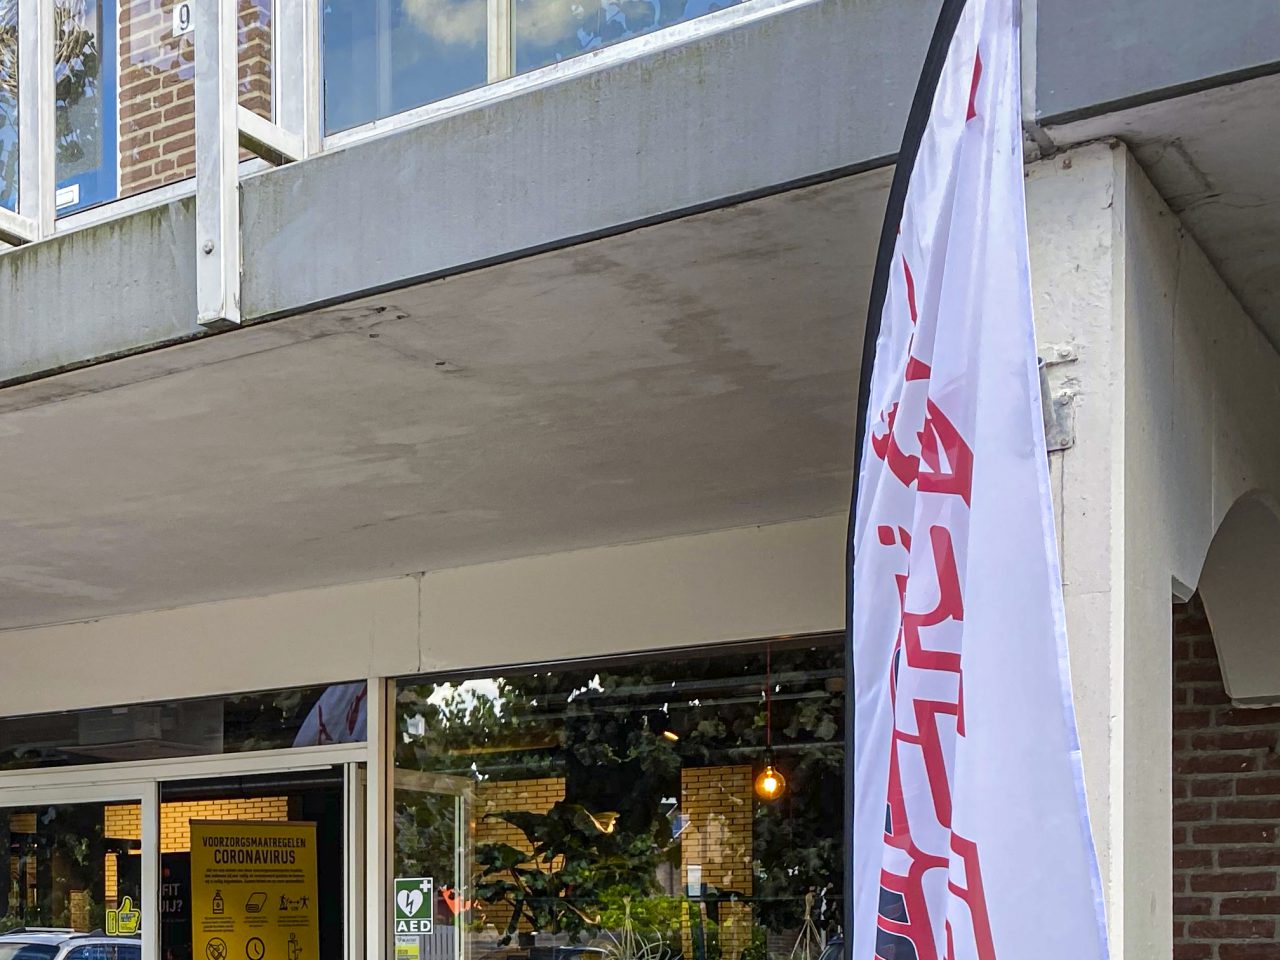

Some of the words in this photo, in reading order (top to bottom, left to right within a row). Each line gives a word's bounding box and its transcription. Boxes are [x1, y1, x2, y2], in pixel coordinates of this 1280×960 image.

[178, 3, 191, 31] 9
[202, 836, 307, 849] VOORZORGSMAATREGELEN
[214, 848, 296, 864] CORONAVIRUS
[397, 920, 431, 932] AED
